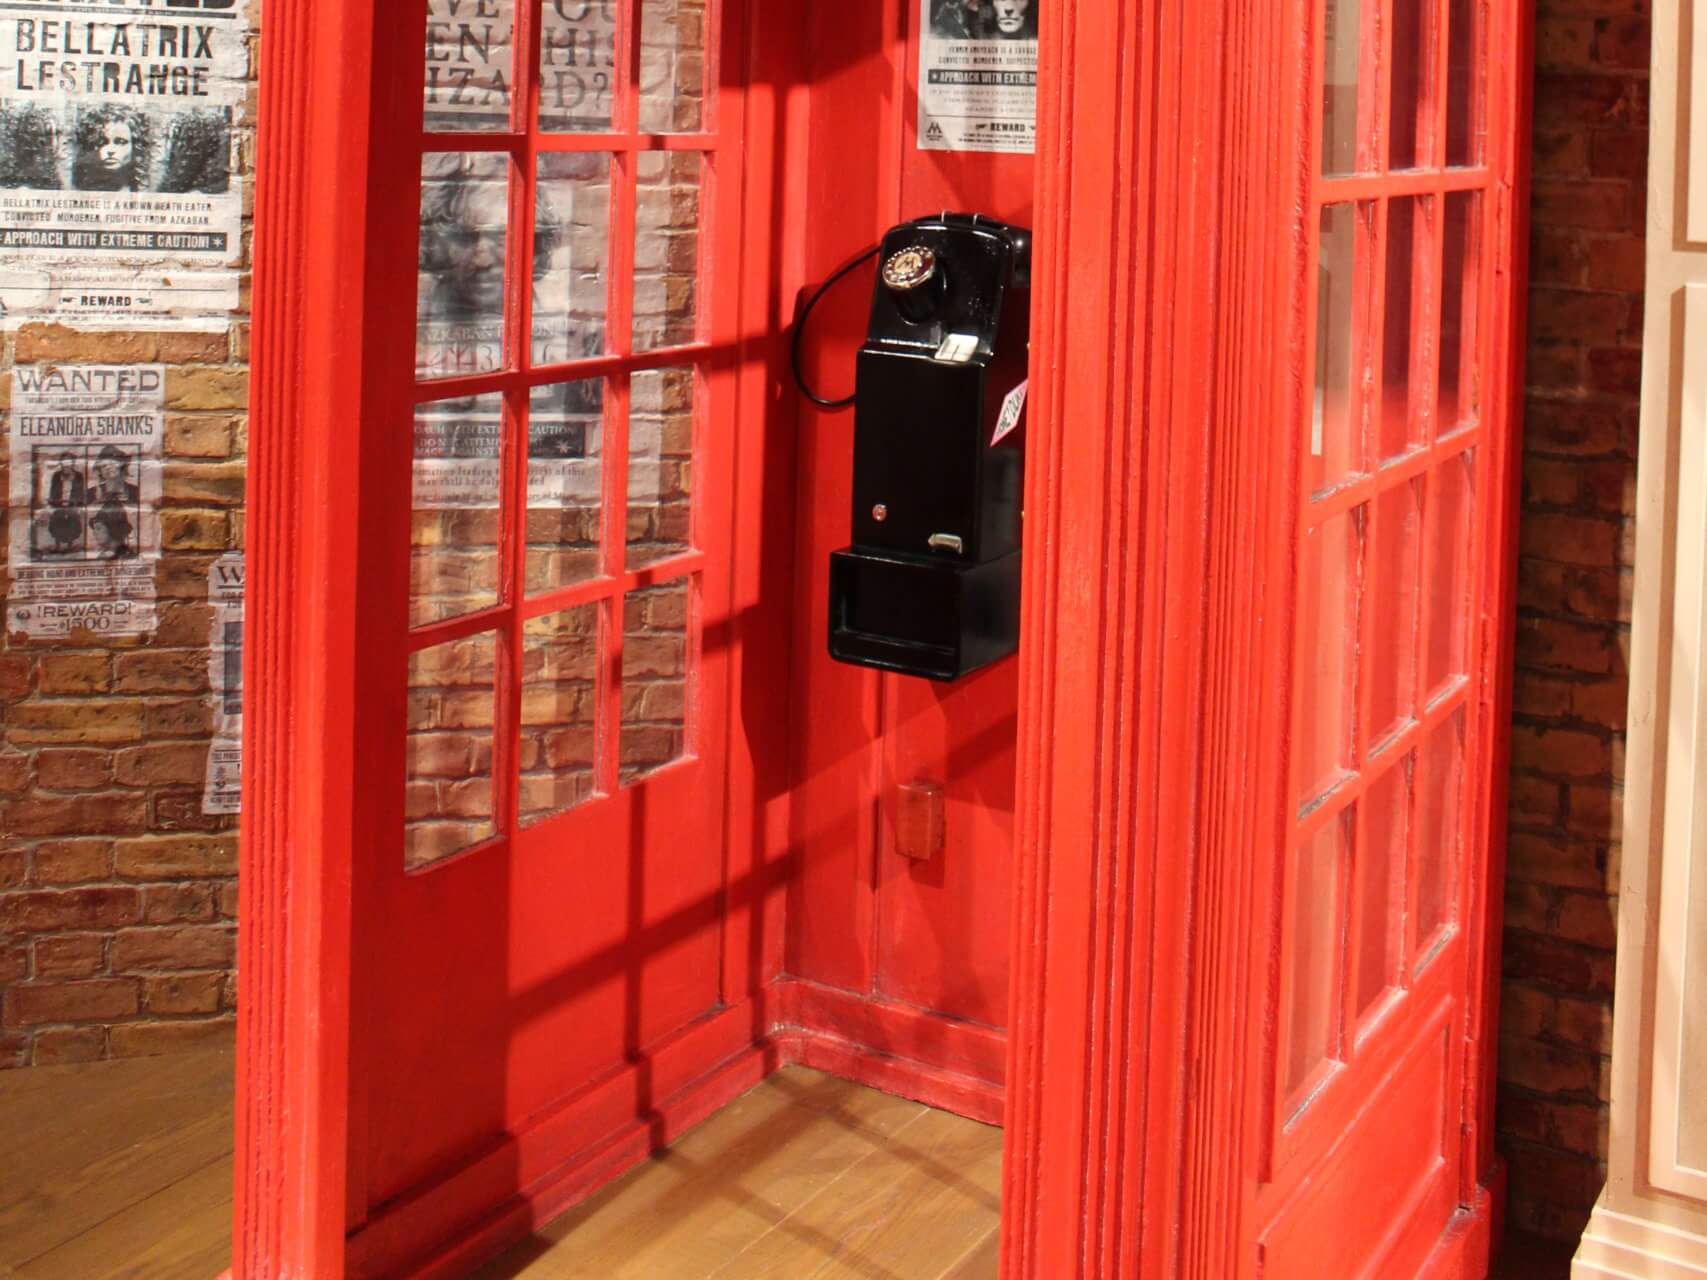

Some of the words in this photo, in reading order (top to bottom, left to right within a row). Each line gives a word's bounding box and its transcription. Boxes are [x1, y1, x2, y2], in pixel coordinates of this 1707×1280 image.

[16, 18, 213, 59] BELLATRIX
[16, 59, 210, 96] LESTRANGE
[990, 122, 1026, 132] REWARD
[4, 231, 64, 245] APPROACH
[68, 232, 97, 246] WITH
[100, 232, 154, 248] EXTREME
[80, 295, 132, 307] REWARD
[17, 369, 160, 392] WANTED
[20, 416, 93, 437] ELEANDRA
[97, 415, 153, 436] SHANKS
